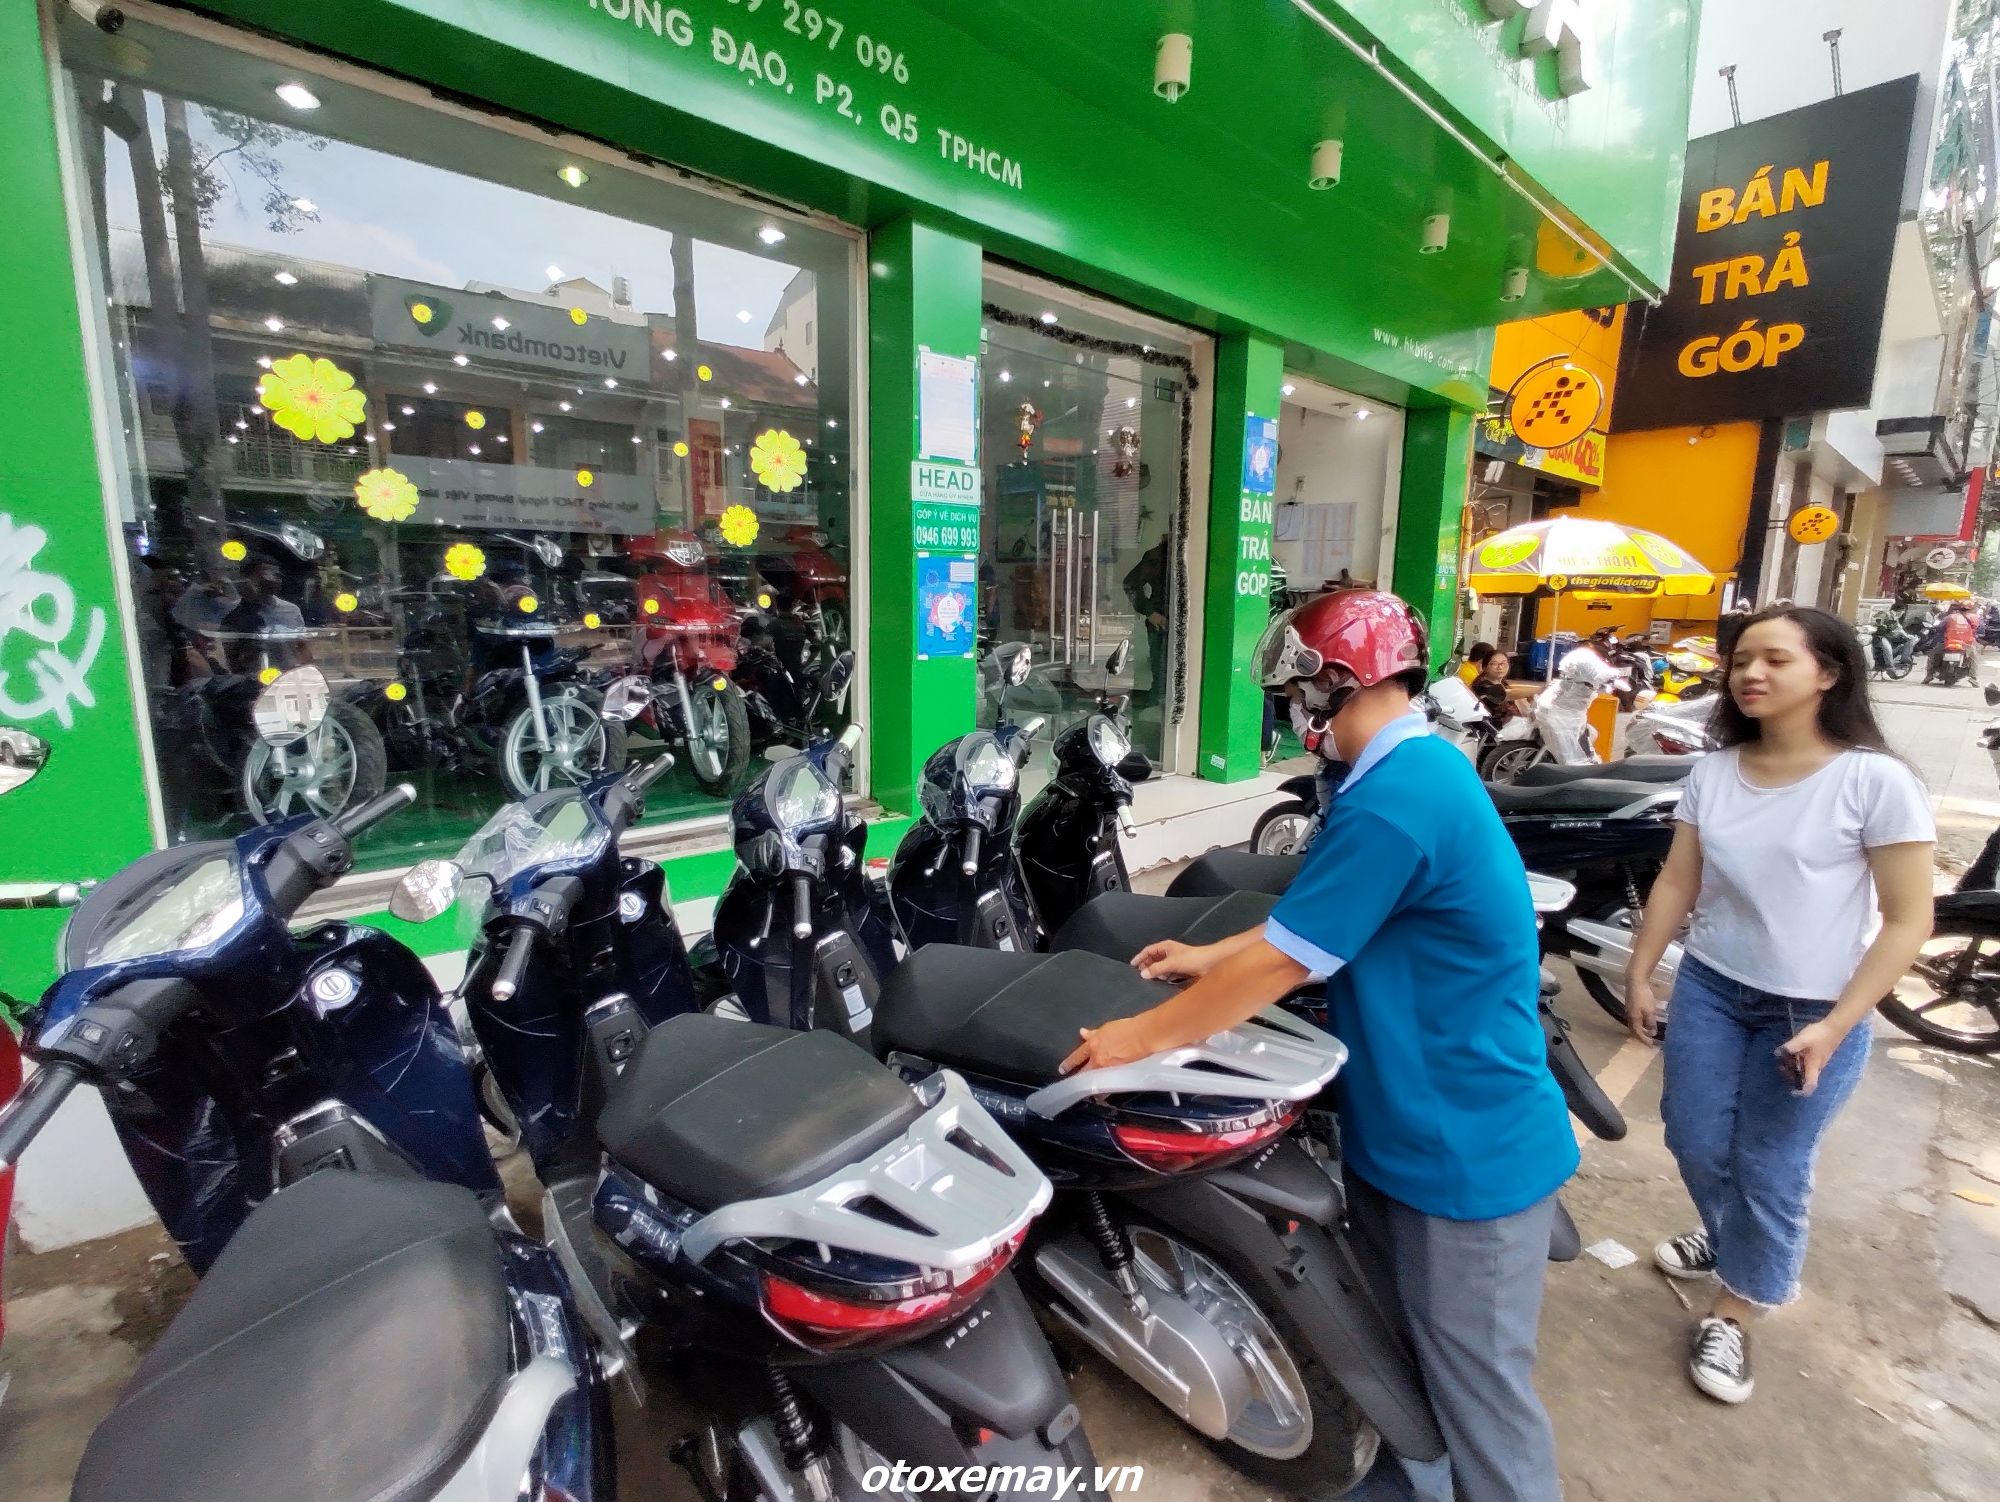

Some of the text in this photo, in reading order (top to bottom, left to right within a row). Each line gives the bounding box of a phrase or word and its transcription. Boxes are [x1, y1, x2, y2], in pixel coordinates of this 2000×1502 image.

[783, 0, 909, 84] 297 096
[880, 104, 918, 144] Q5
[937, 128, 1022, 189] TPHCM
[1696, 160, 1830, 234] BÁN
[1692, 231, 1809, 305] TRẢ
[1677, 319, 1805, 378] GÓP
[919, 467, 974, 491] HEAD
[916, 508, 932, 519] GÓP
[951, 512, 966, 522] DỊCH
[1240, 493, 1272, 524] BÁN
[916, 525, 977, 547] 0946 699 993
[1240, 530, 1269, 560] TRẢ
[1237, 565, 1268, 597] GÓP
[1570, 575, 1657, 589] thegioididong
[1253, 1142, 1280, 1170] PEGA
[944, 1310, 992, 1349] PEGA
